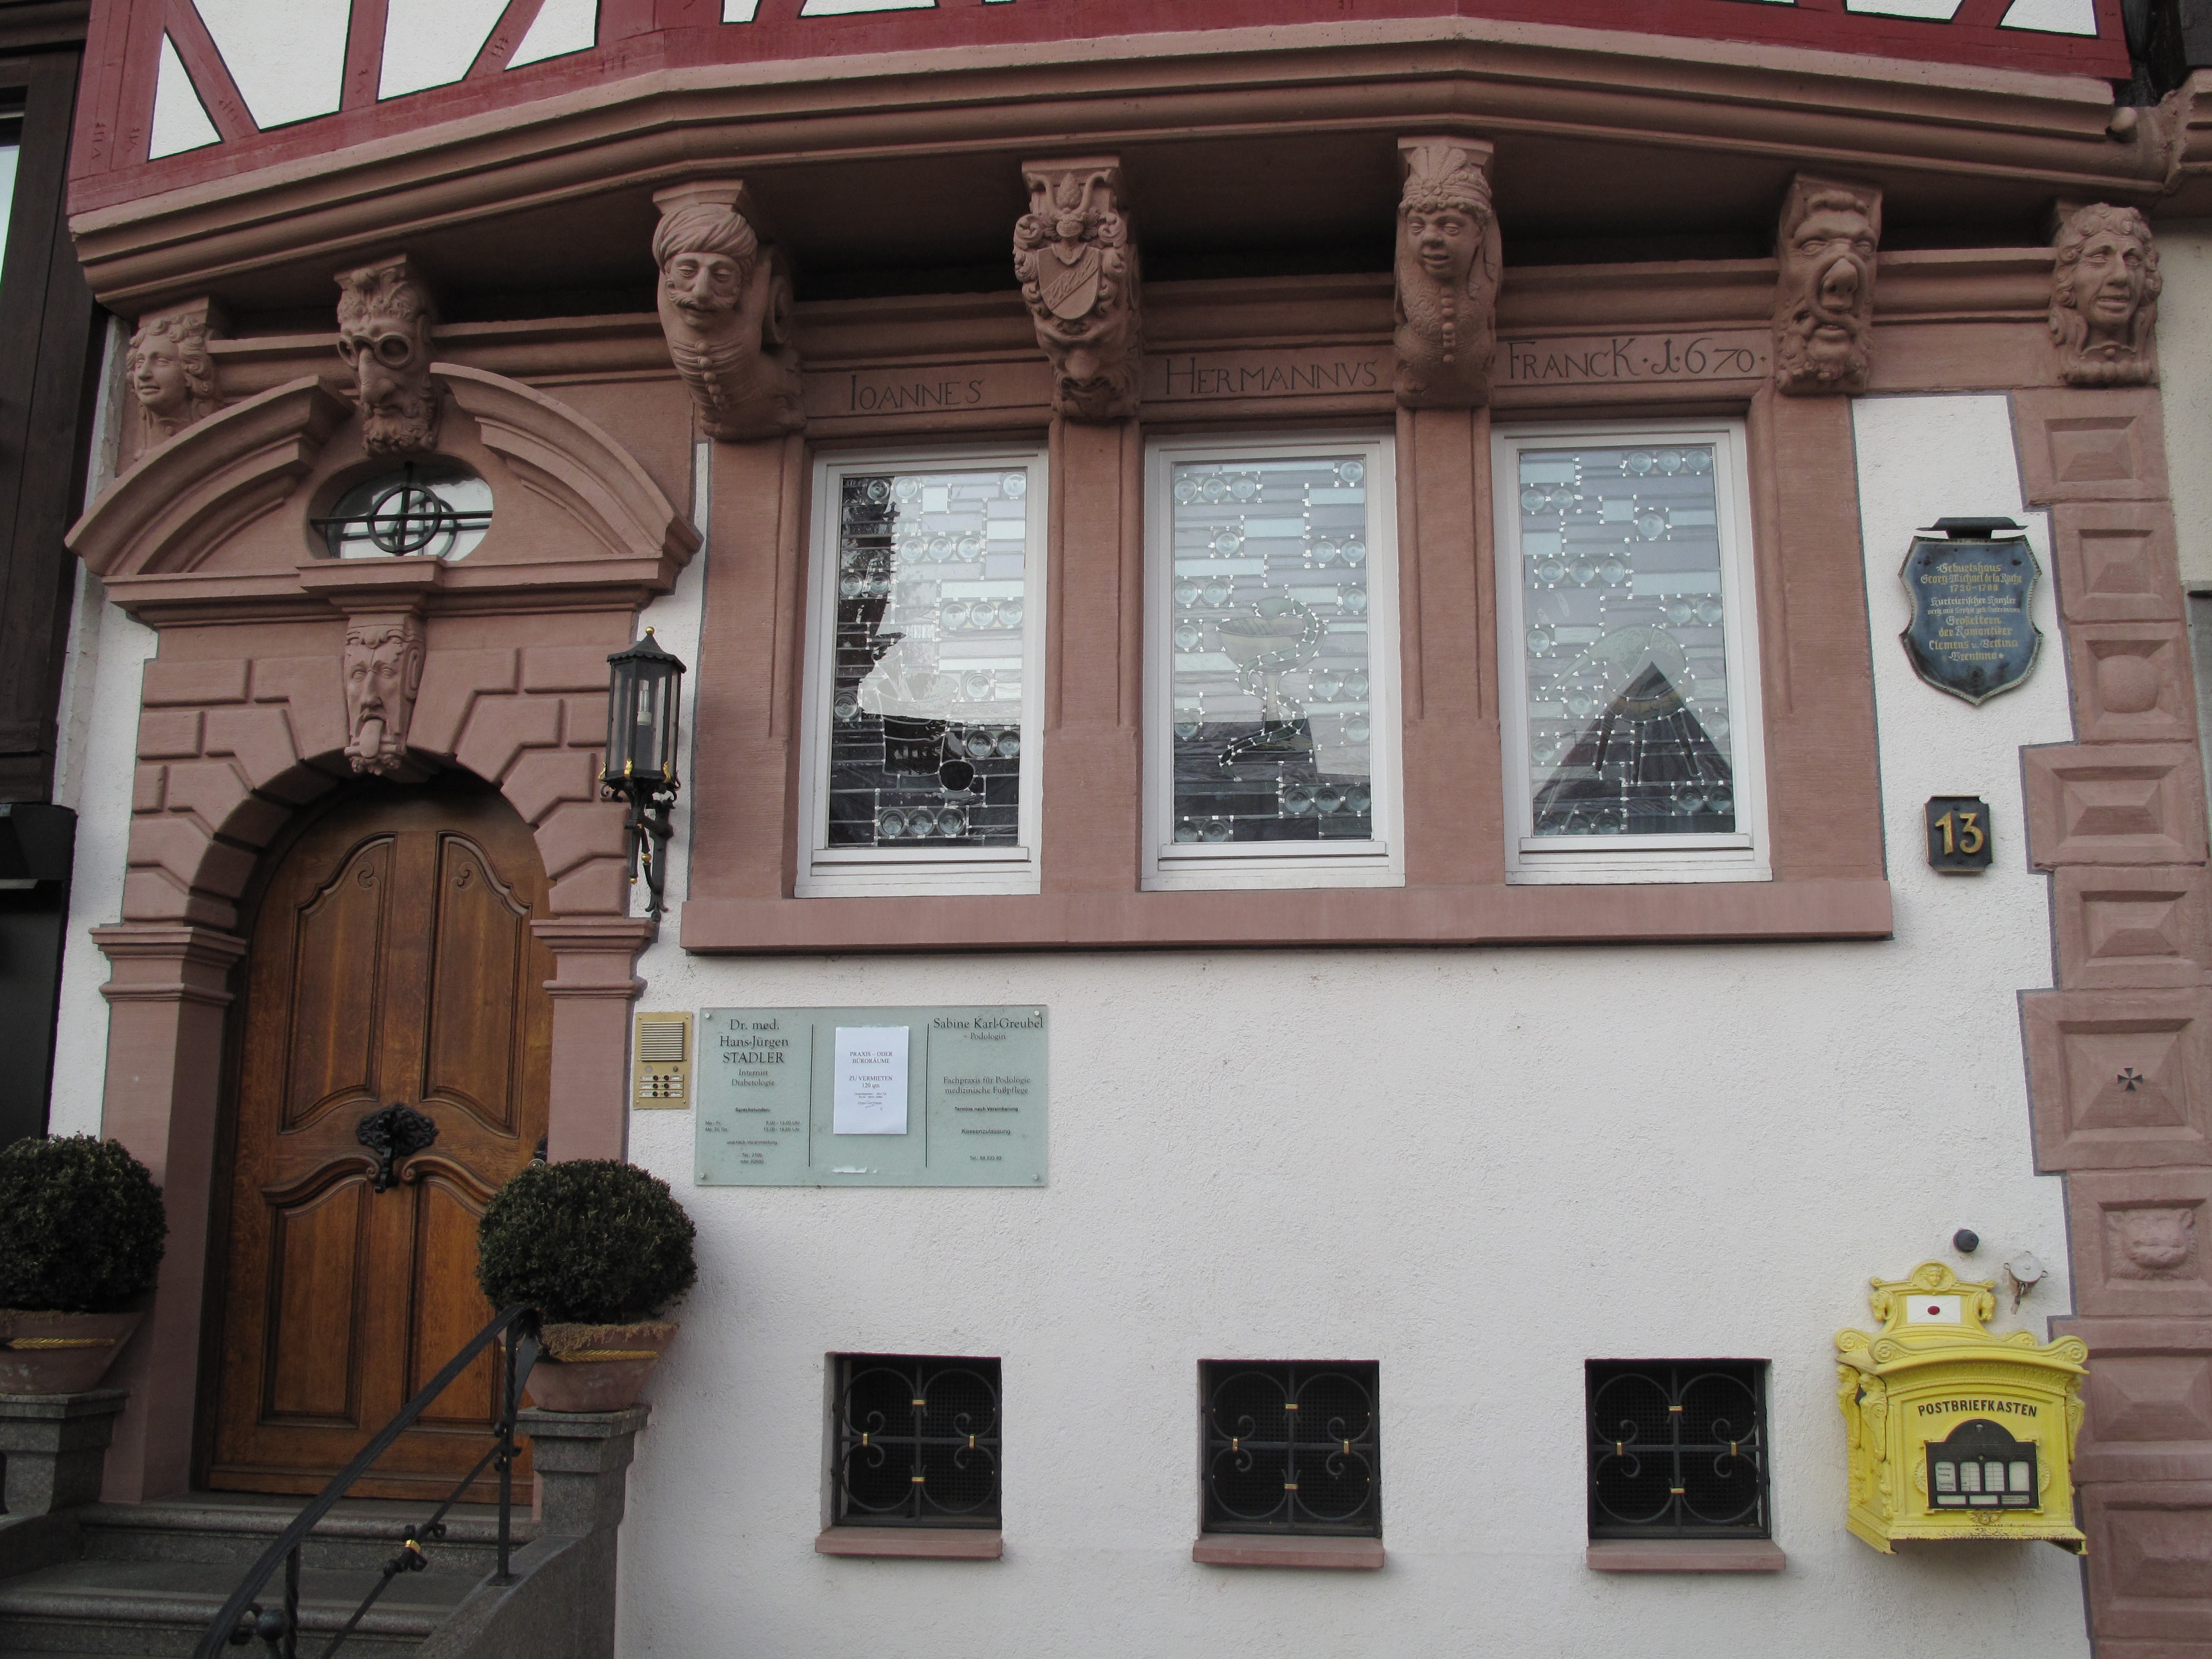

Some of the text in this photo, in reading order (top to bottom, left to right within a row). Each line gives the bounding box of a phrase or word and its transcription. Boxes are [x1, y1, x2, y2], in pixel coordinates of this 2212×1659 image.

[1508, 338, 1641, 380] FRANCK
[1166, 357, 1380, 395] HERMANNVS
[850, 375, 984, 411] IOANNES
[1937, 562, 2002, 574] Geburtshaus
[1920, 574, 1948, 585] Georg
[1949, 574, 1984, 585] Michael
[1988, 597, 2016, 607] Kanzler
[1939, 627, 1954, 637] der
[1929, 640, 1969, 650] Clemens
[1934, 811, 1985, 855] 13
[730, 1019, 779, 1030] Dr. med.
[934, 1017, 1043, 1028] Sabine Karl-Greubel
[720, 1036, 788, 1048] Hans-Jürgen
[970, 1032, 1006, 1041] Podologin
[723, 1052, 784, 1063] STADLER
[993, 1086, 1028, 1094] Fußpflege
[1918, 1399, 2036, 1417] POSTBRIEFKASTEN
